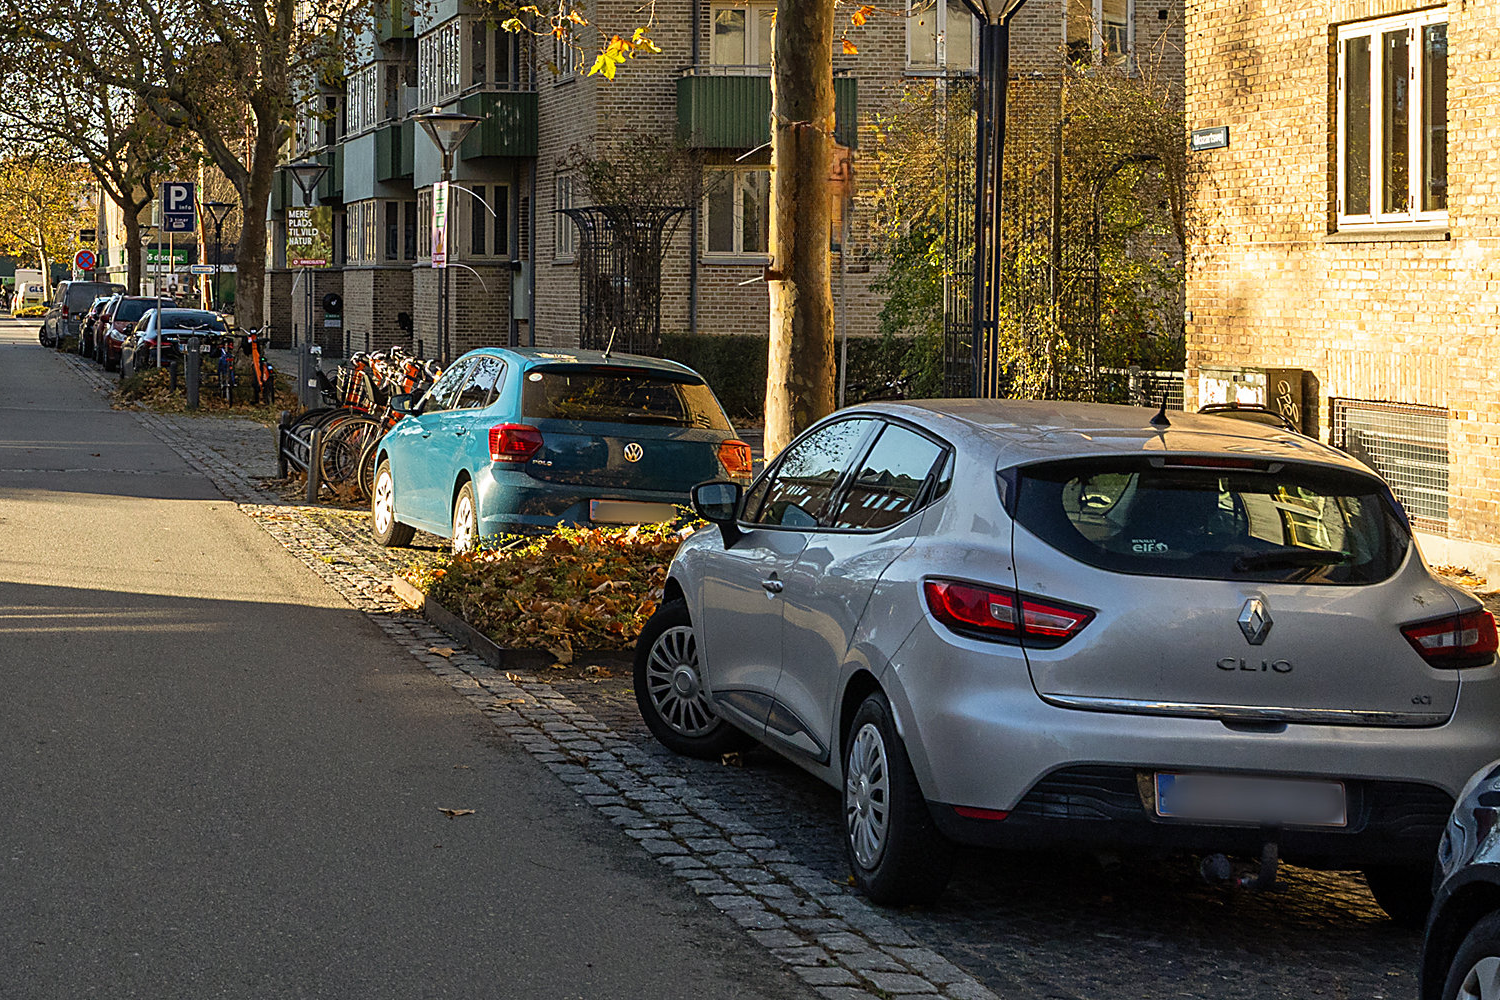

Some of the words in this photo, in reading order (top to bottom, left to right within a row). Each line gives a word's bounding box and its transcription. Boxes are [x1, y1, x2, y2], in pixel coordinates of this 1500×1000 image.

[170, 186, 187, 210] P
[288, 210, 308, 218] MERE
[288, 219, 312, 227] PLADS
[289, 228, 300, 236] TIL
[301, 228, 318, 236] VILD
[289, 237, 312, 245] NATUR
[1216, 657, 1293, 673] CLIO
